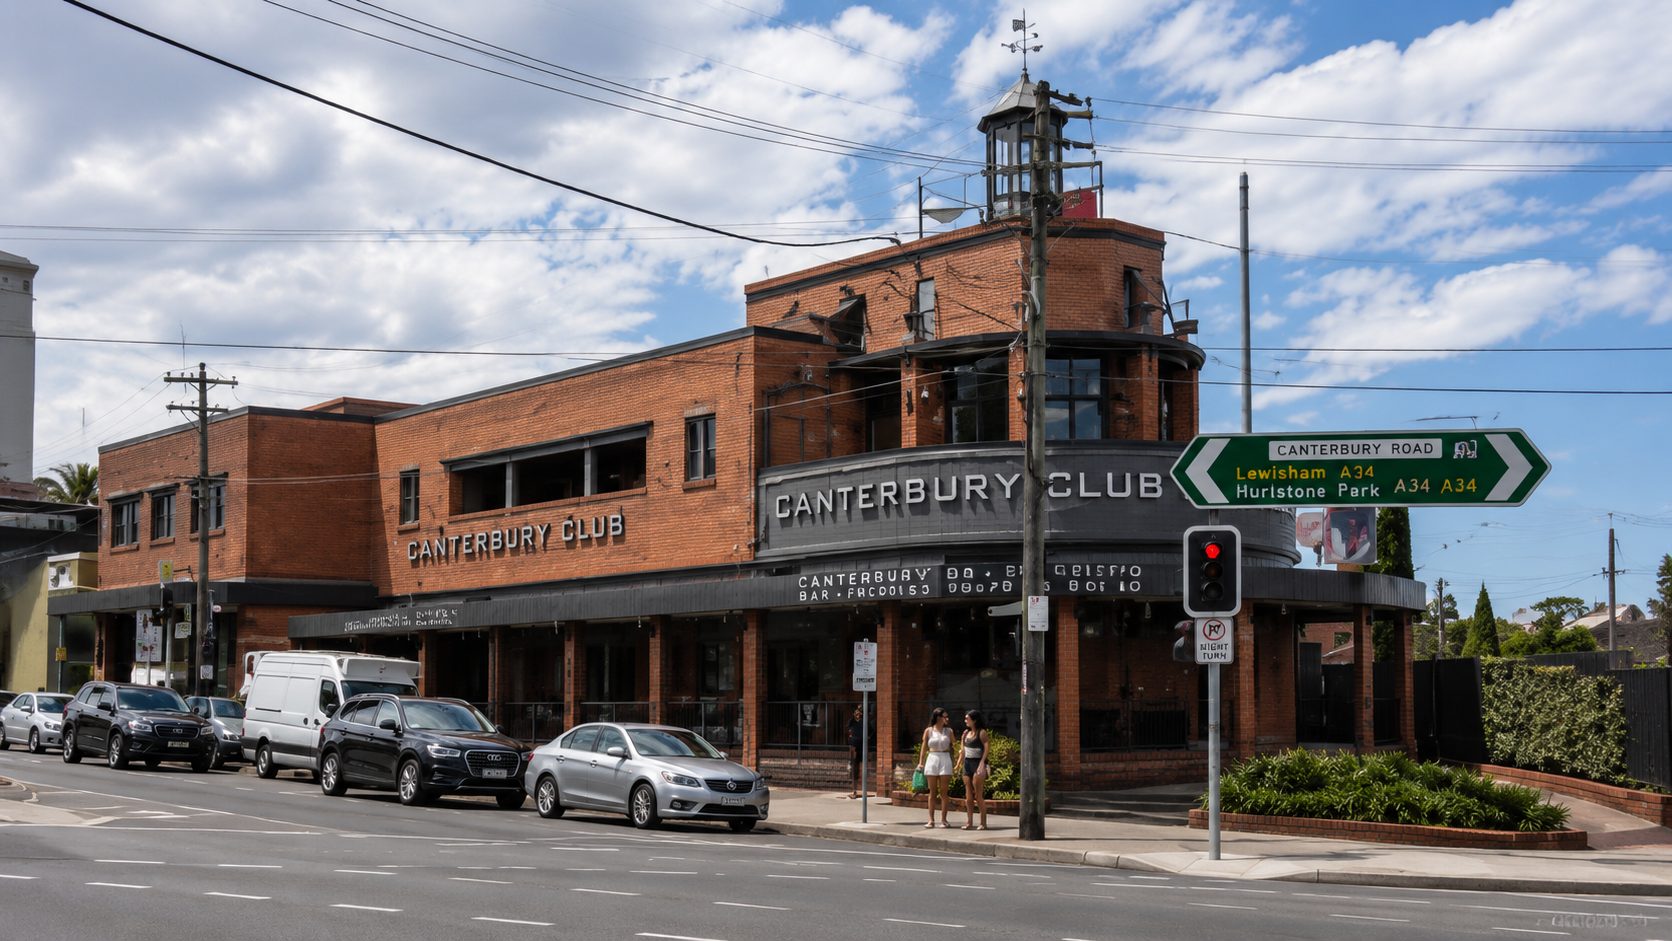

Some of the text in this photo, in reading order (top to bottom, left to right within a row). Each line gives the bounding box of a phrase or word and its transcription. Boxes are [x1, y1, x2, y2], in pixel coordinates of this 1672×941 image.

[1277, 442, 1434, 456] CANTERBURY ROAD
[1236, 465, 1375, 480] Lewisham A34
[775, 472, 1163, 518] CANTERBURY CLUB
[1236, 478, 1477, 499] Hurlstone Park A34 A34
[407, 514, 624, 560] CANTERBURY CLUB
[799, 589, 829, 601] BAR
